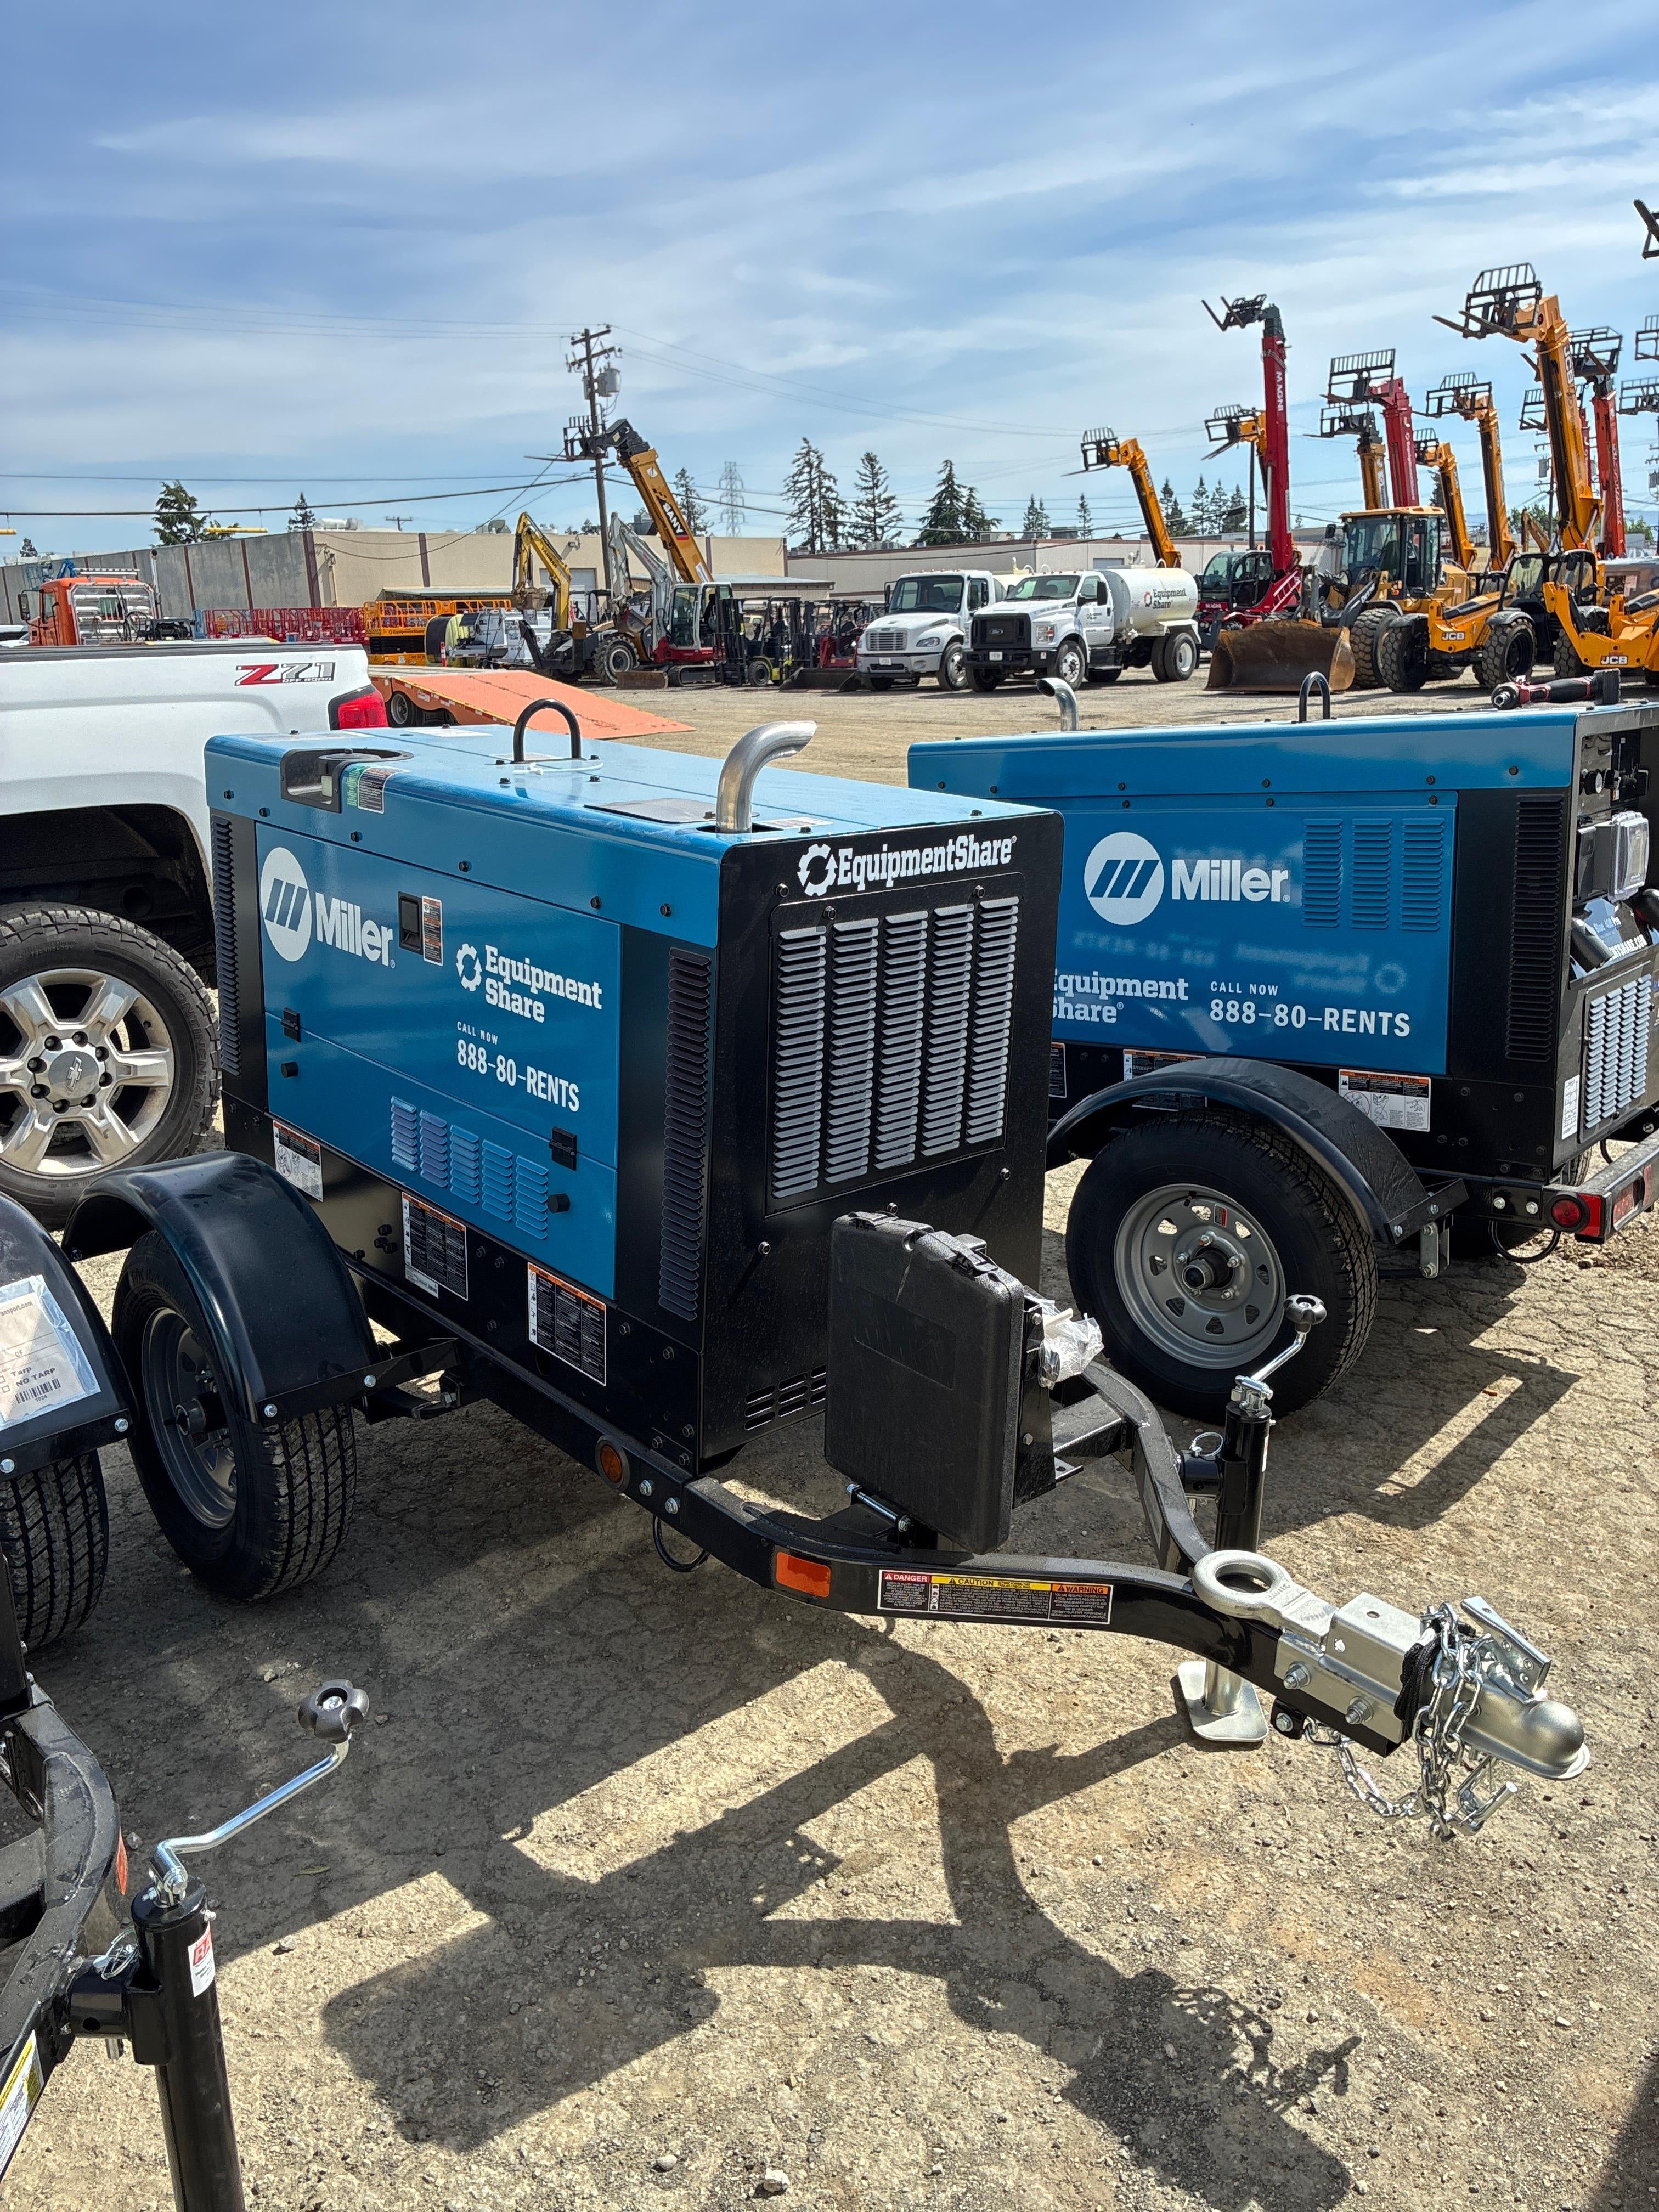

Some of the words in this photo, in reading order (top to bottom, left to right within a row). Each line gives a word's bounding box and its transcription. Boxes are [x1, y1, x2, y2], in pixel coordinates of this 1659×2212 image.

[1563, 346, 1574, 386] JCB
[1276, 371, 1284, 412] MAGNI
[663, 502, 684, 534] SANY
[541, 546, 558, 568] YANMAR
[1152, 600, 1171, 609] Share
[1153, 588, 1187, 600] Equipment
[235, 662, 336, 685] Z71
[1602, 656, 1627, 664] JCB
[837, 835, 1012, 891] EquipmentShare
[1171, 859, 1289, 902] Miller
[315, 892, 393, 967] Miller
[485, 945, 602, 1009] Equipment
[1054, 968, 1189, 1001] quipment
[1210, 981, 1245, 994] CALL
[1250, 983, 1278, 996] NOW
[485, 982, 545, 1023] Share
[1210, 998, 1411, 1037] 888-80-RENTS
[165, 978, 208, 1112] CONTINENTAL
[457, 1021, 476, 1037] CALL
[480, 1029, 498, 1045] NOW
[457, 1039, 580, 1113] 888-80-RENTS
[10, 1367, 32, 1377] Tarp
[16, 1378, 30, 1387] NO
[31, 1367, 56, 1381] TARP
